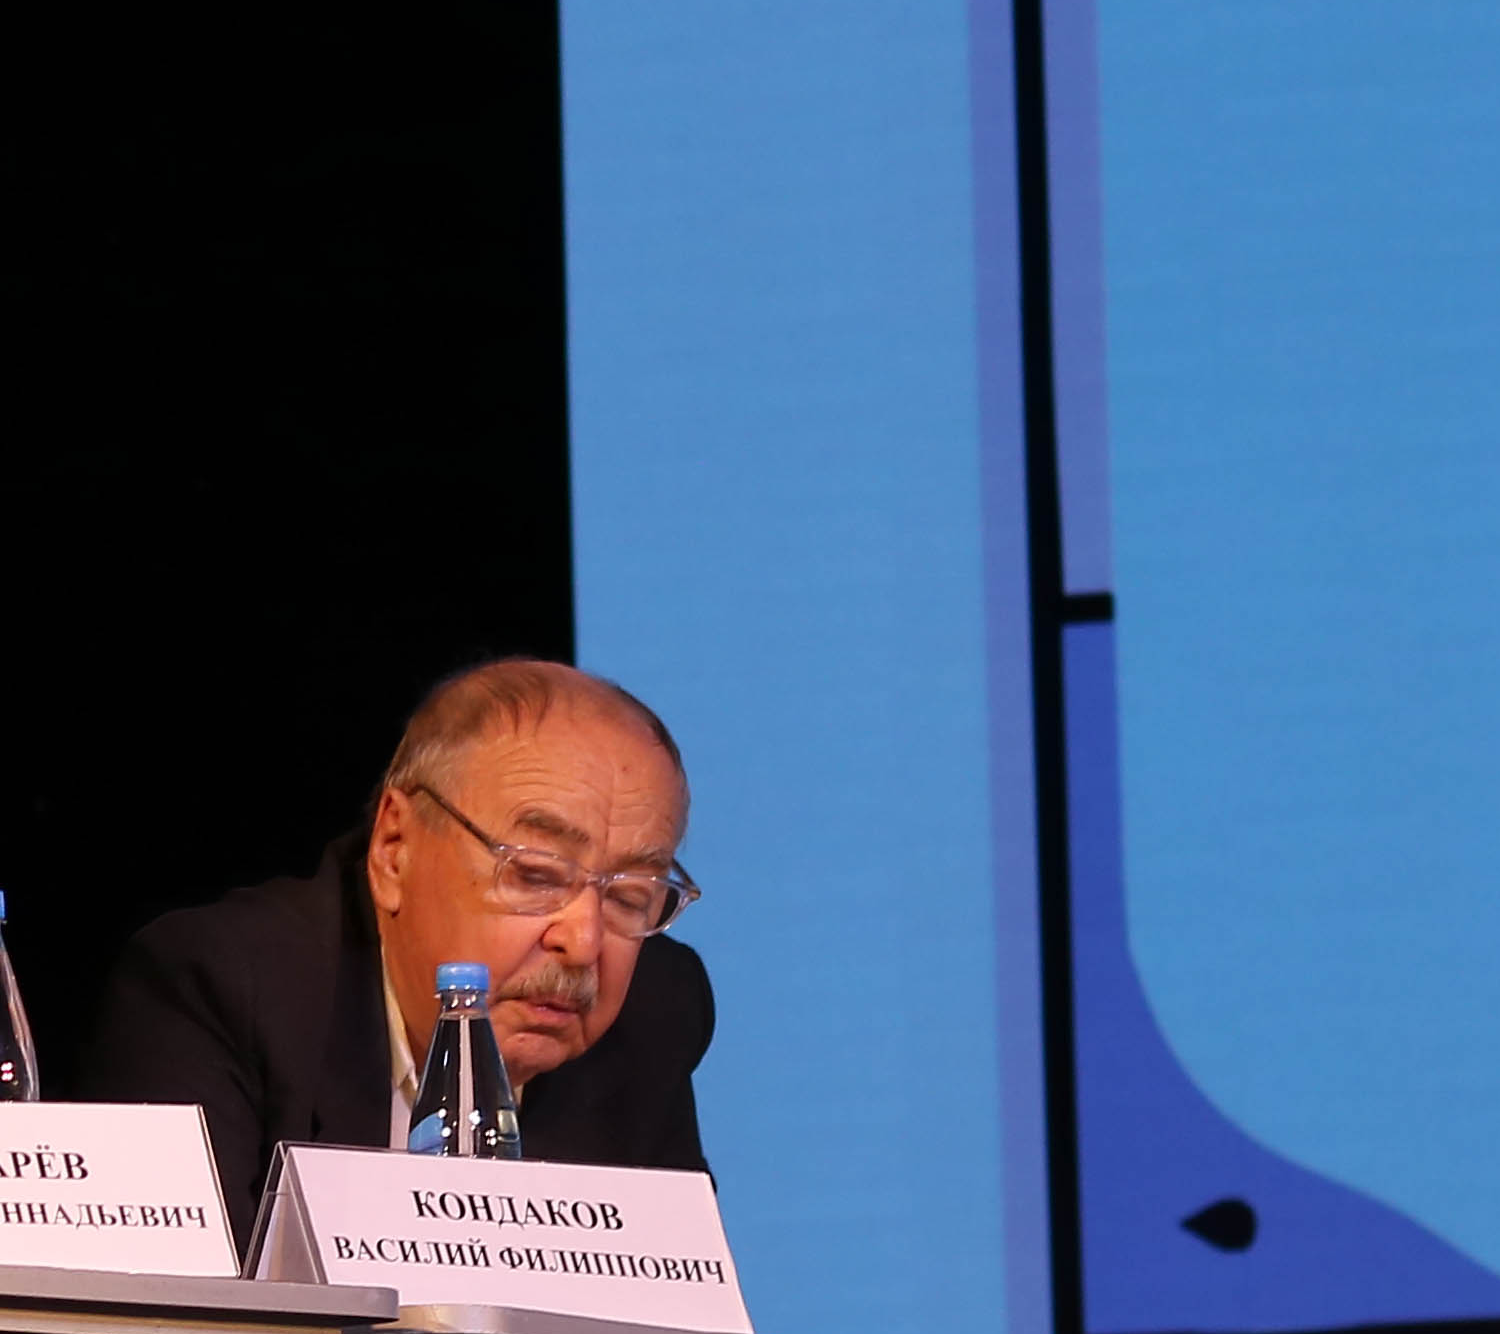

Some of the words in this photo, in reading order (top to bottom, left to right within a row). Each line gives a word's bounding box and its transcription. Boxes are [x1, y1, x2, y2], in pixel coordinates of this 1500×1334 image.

[411, 1188, 625, 1231] КОНДАКОВ
[332, 1234, 493, 1269] ВАСИЛИЙ
[498, 1244, 728, 1285] ФИЛИППОВИЧ
